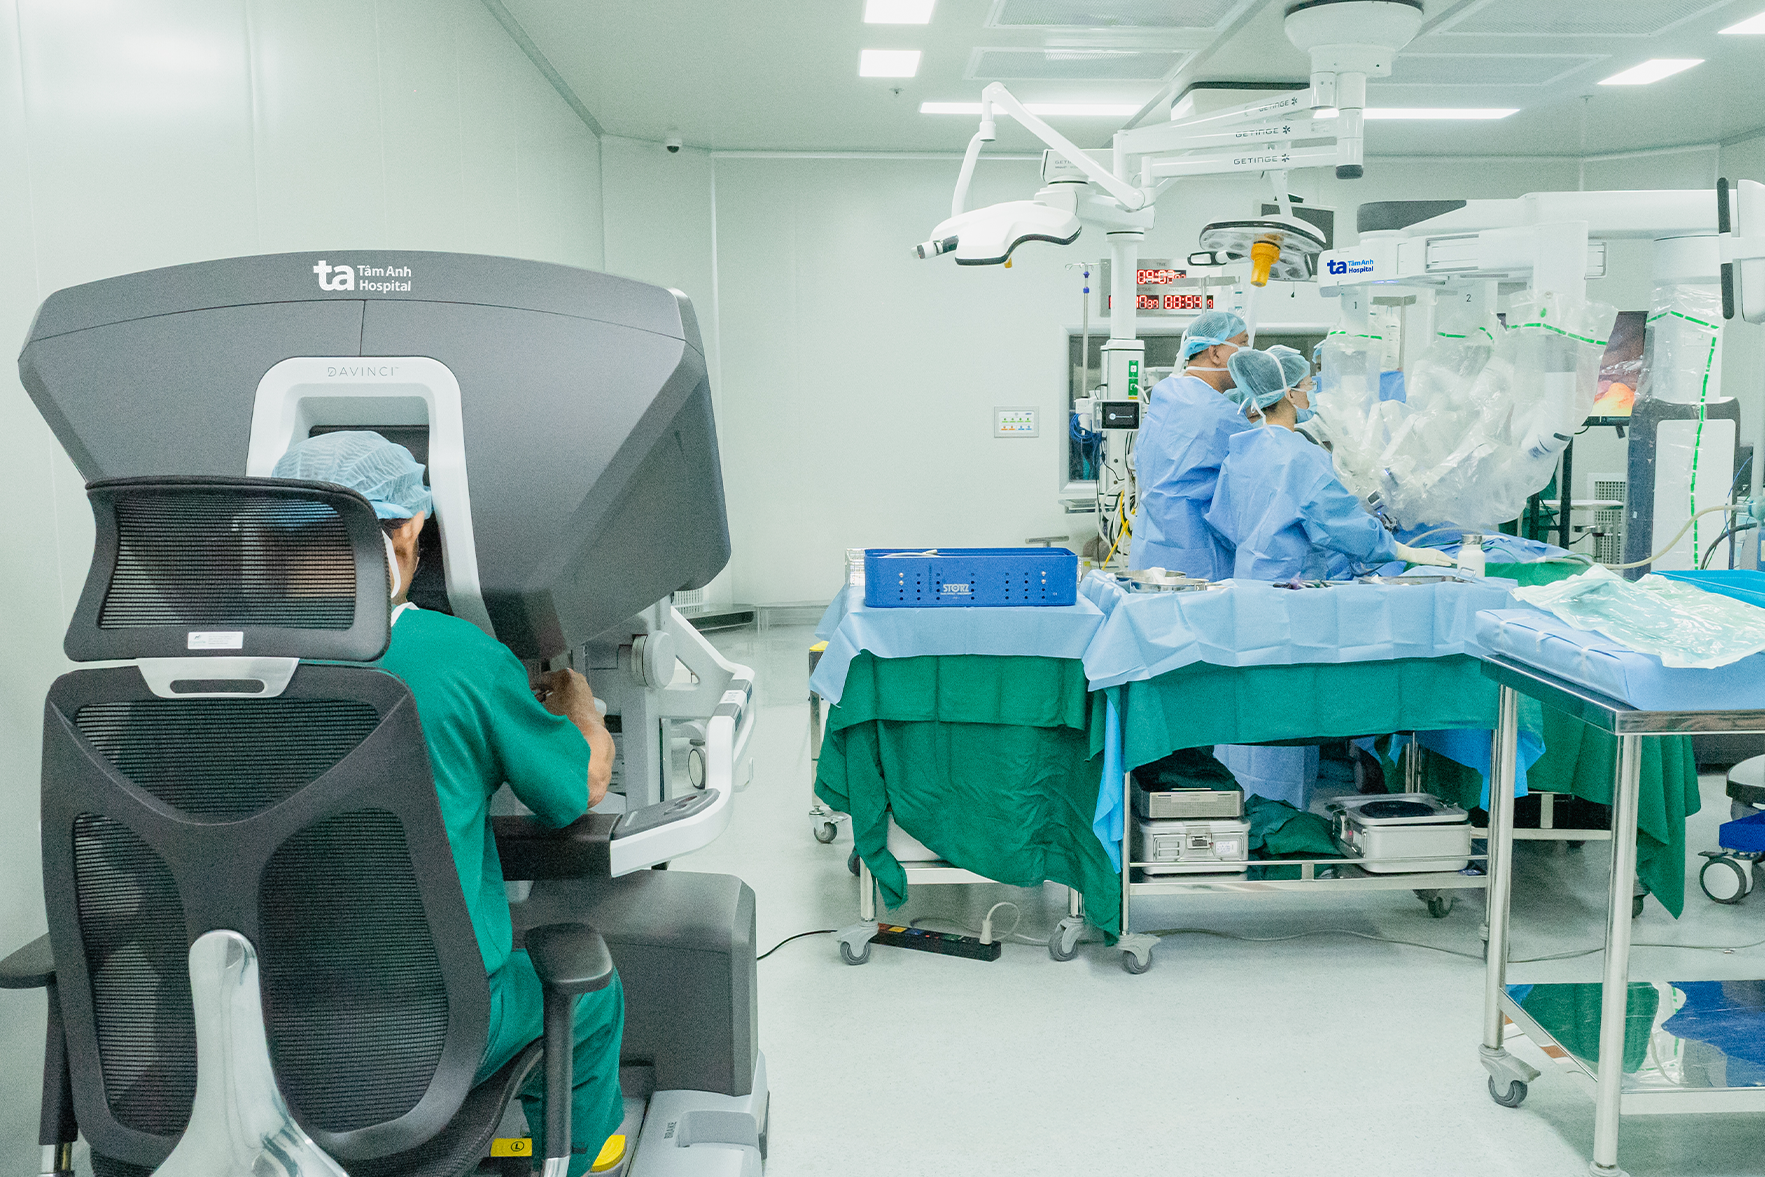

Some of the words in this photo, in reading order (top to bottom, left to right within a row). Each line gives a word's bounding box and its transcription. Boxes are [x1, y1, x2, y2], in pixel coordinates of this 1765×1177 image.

[1235, 128, 1279, 138] GETINGE
[1233, 156, 1278, 165] GETINGE
[357, 265, 384, 276] Tâm
[386, 266, 412, 277] Anh
[1327, 260, 1347, 275] ta
[1348, 266, 1374, 274] Hospital
[313, 260, 355, 291] ta
[360, 280, 411, 293] Hospital
[1466, 294, 1472, 302] 2
[1354, 301, 1358, 309] 1
[943, 584, 969, 592] STORZ
